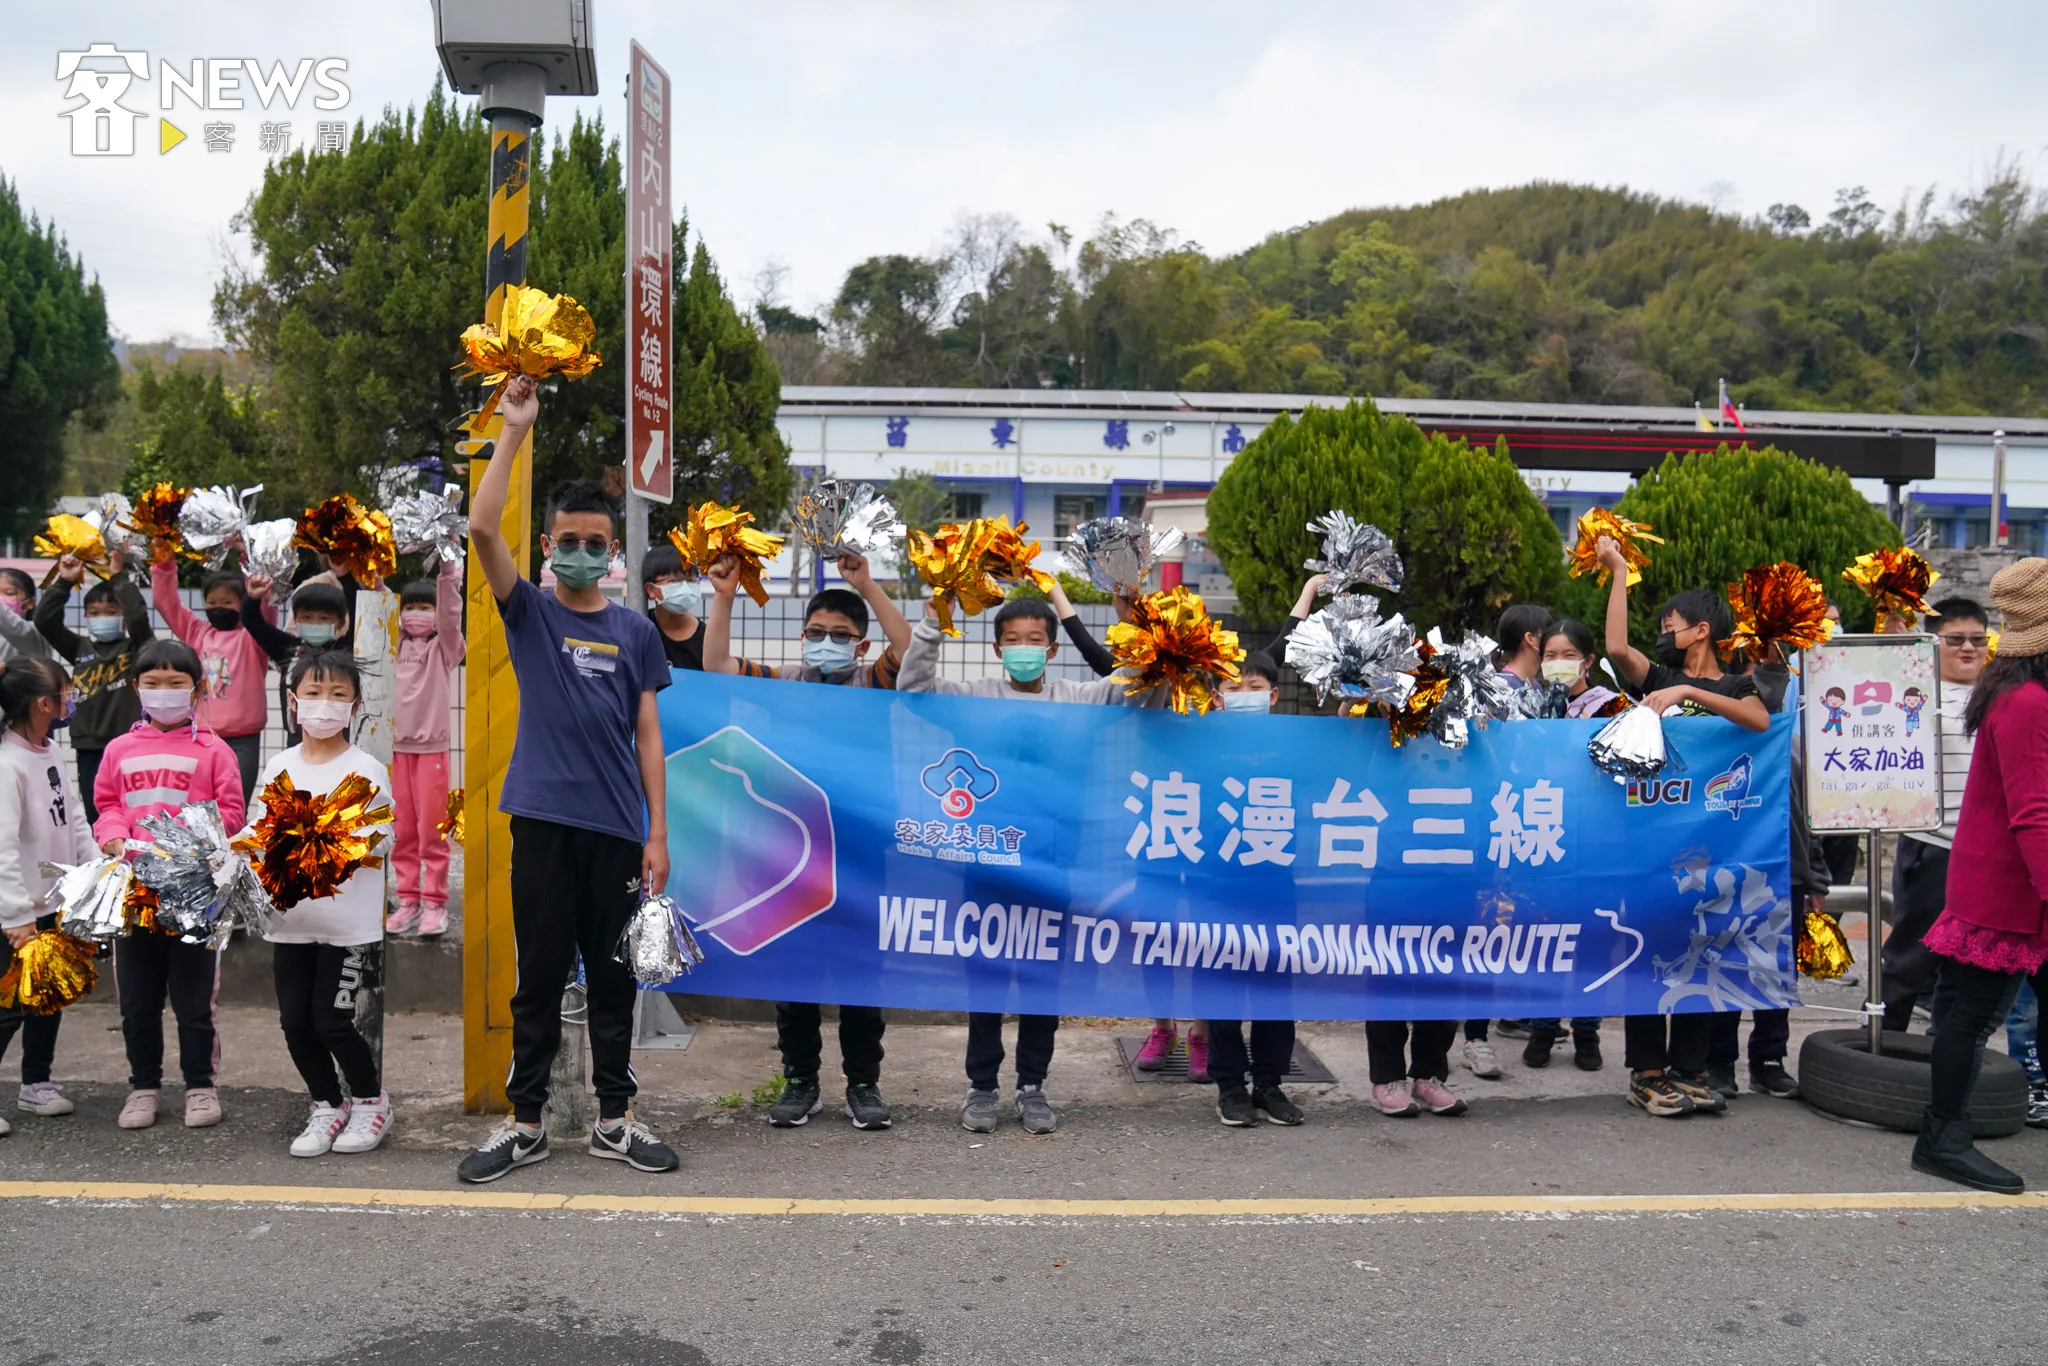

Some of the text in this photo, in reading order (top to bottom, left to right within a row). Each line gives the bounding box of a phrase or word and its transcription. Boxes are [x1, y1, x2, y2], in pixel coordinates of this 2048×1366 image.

[640, 141, 663, 388] 內山環線
[634, 383, 669, 410] Cycling Route
[1020, 460, 1115, 480] County
[1822, 745, 1925, 772] 大家加油
[1639, 779, 1691, 805] UCI
[1123, 770, 1567, 868] 浪漫台三線
[894, 818, 1026, 852] 客家委員會
[936, 848, 976, 862] Affairs
[977, 851, 1022, 866] Council
[878, 895, 1582, 976] WELCOME TO TAIWAN ROMANTIC ROUTE
[333, 945, 366, 1010] PUM
